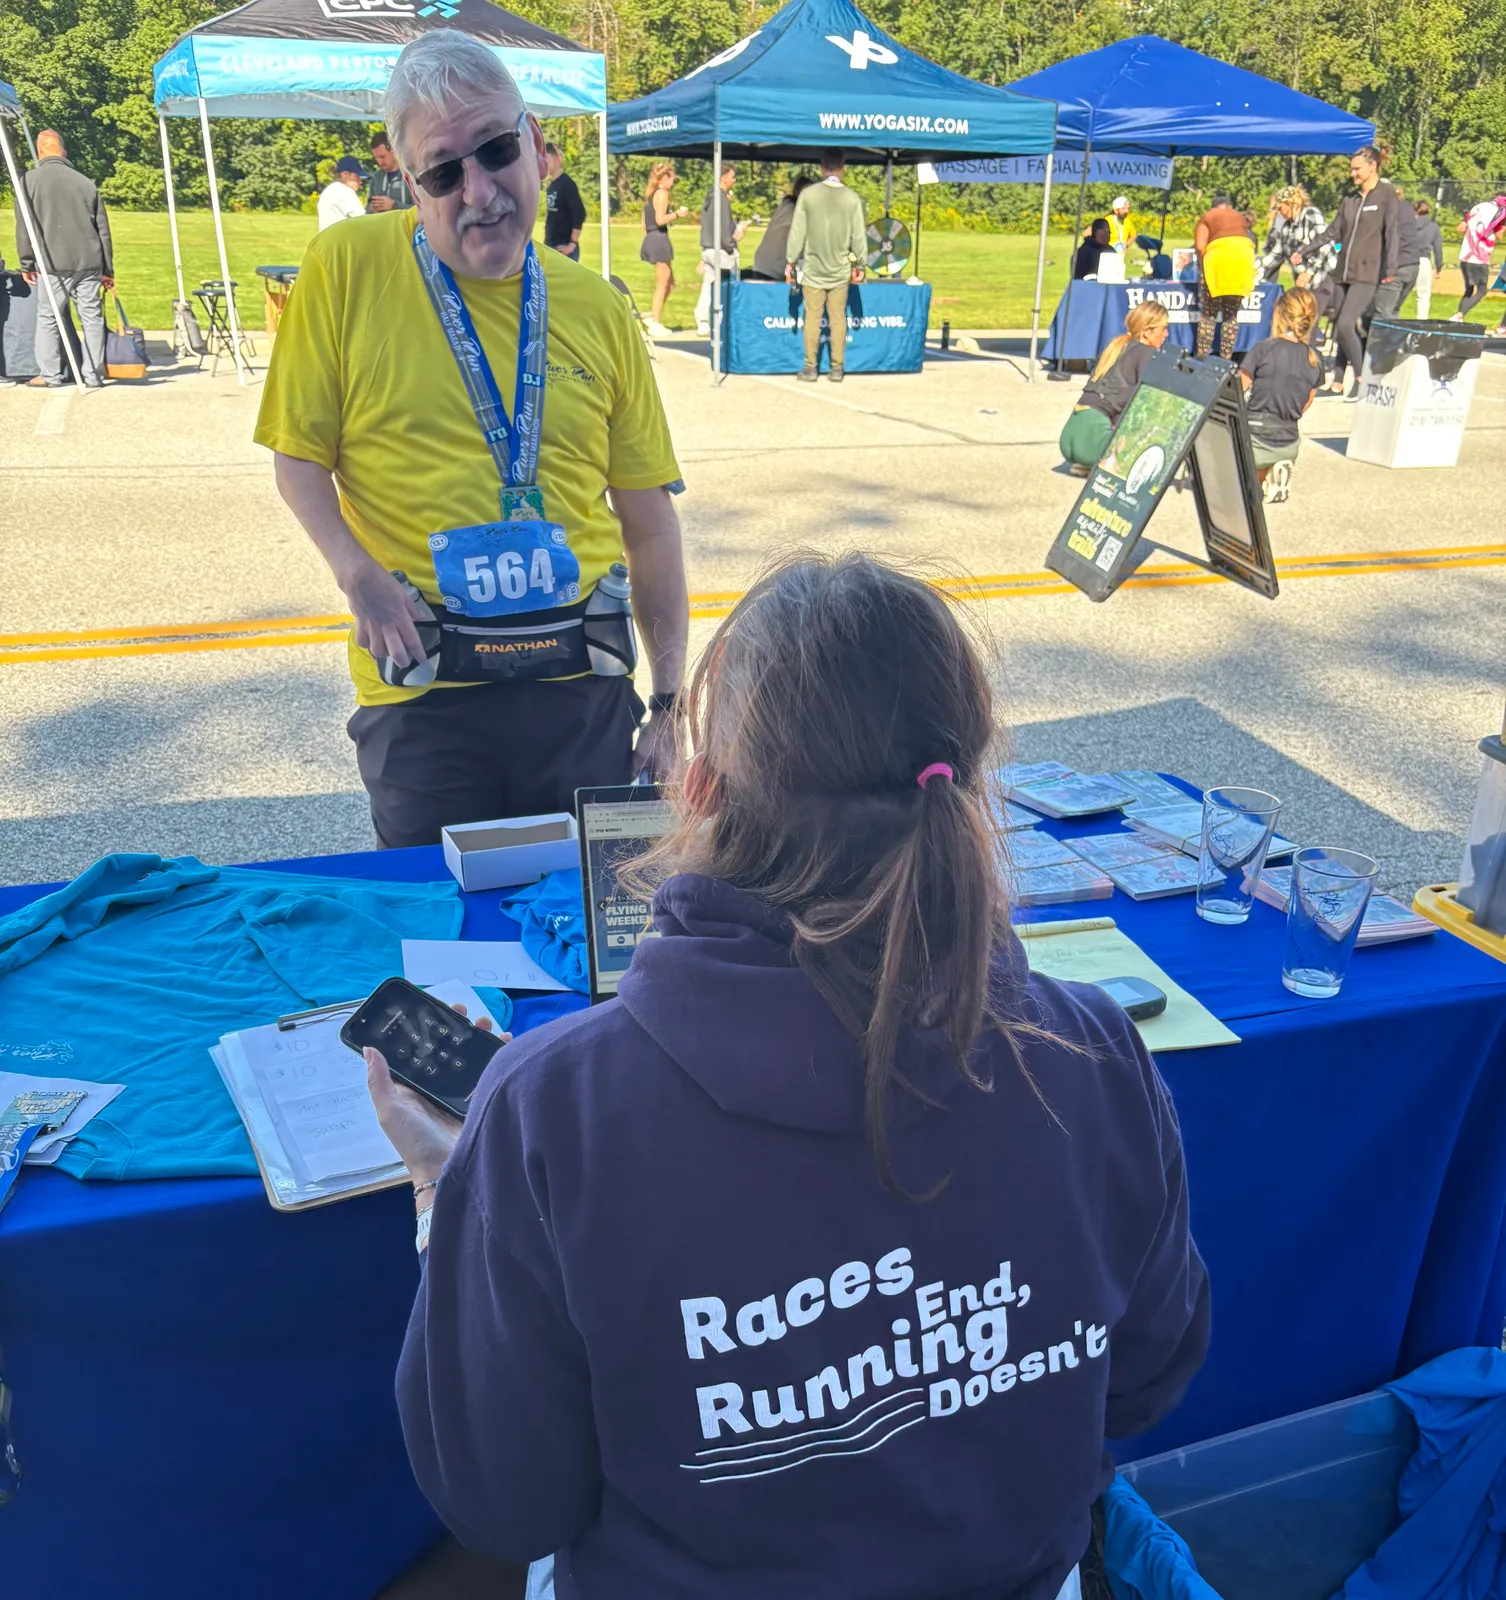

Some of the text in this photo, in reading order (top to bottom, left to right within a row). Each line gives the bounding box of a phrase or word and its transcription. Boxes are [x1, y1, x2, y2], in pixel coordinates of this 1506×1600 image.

[625, 115, 678, 137] WWW.YOGASIX.COM
[818, 112, 969, 135] WWW.YOGASIX.COM
[932, 158, 1008, 176] MASSAGE
[1107, 163, 1169, 179] WAXING
[440, 311, 466, 361] HALF MARATHON
[441, 290, 481, 373] River Run
[1365, 383, 1398, 408] TRASH
[511, 401, 534, 482] River Run
[528, 418, 541, 469] HALF MARATHON
[464, 548, 556, 603] 564
[491, 638, 558, 653] NATHAN
[606, 904, 648, 916] FLYING
[679, 1246, 1032, 1360] Races End,
[695, 1305, 1108, 1440] Running Doesn't
